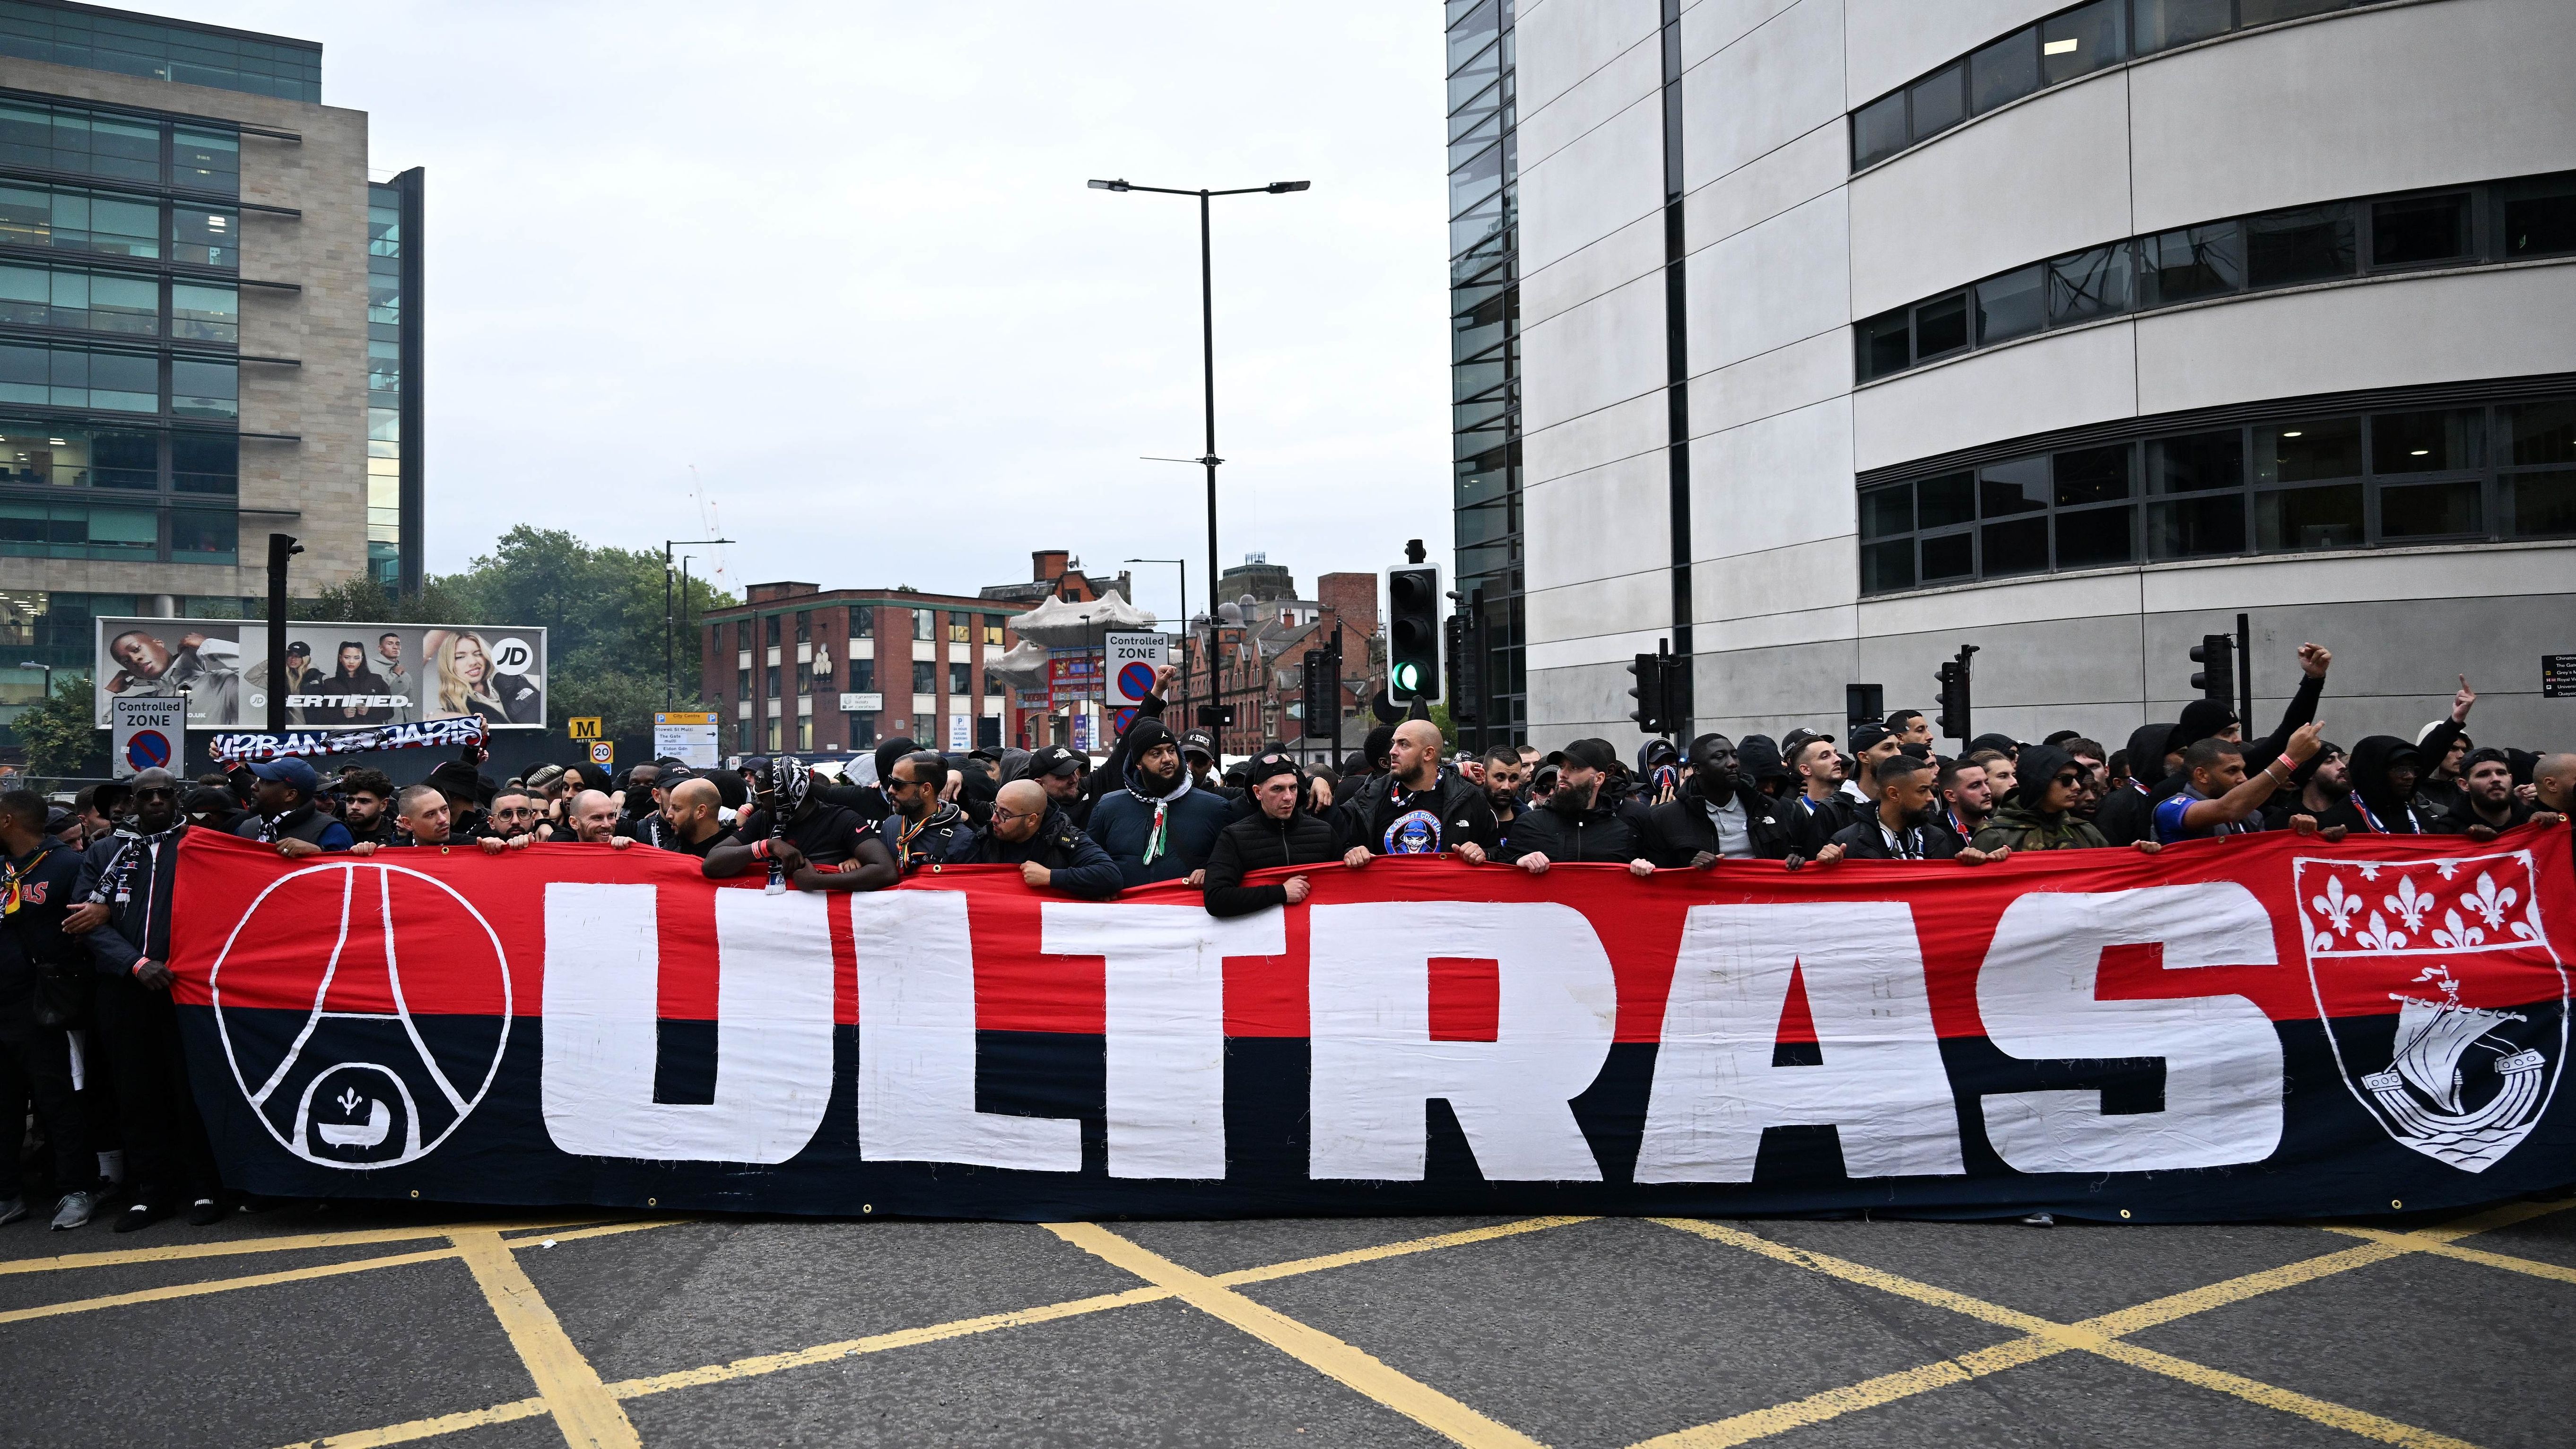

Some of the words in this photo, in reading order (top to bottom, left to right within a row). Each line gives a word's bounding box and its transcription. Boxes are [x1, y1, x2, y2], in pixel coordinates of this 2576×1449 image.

[1111, 636, 1164, 645] Controlled
[497, 647, 527, 665] JD
[1118, 648, 1156, 659] ZONE
[119, 702, 180, 711] Controlled
[286, 695, 413, 707] ERTIFIED.
[127, 715, 170, 726] ZONE
[576, 721, 595, 737] M
[1393, 813, 1419, 828] COMBAT
[541, 879, 2284, 1184] ULTRAS
